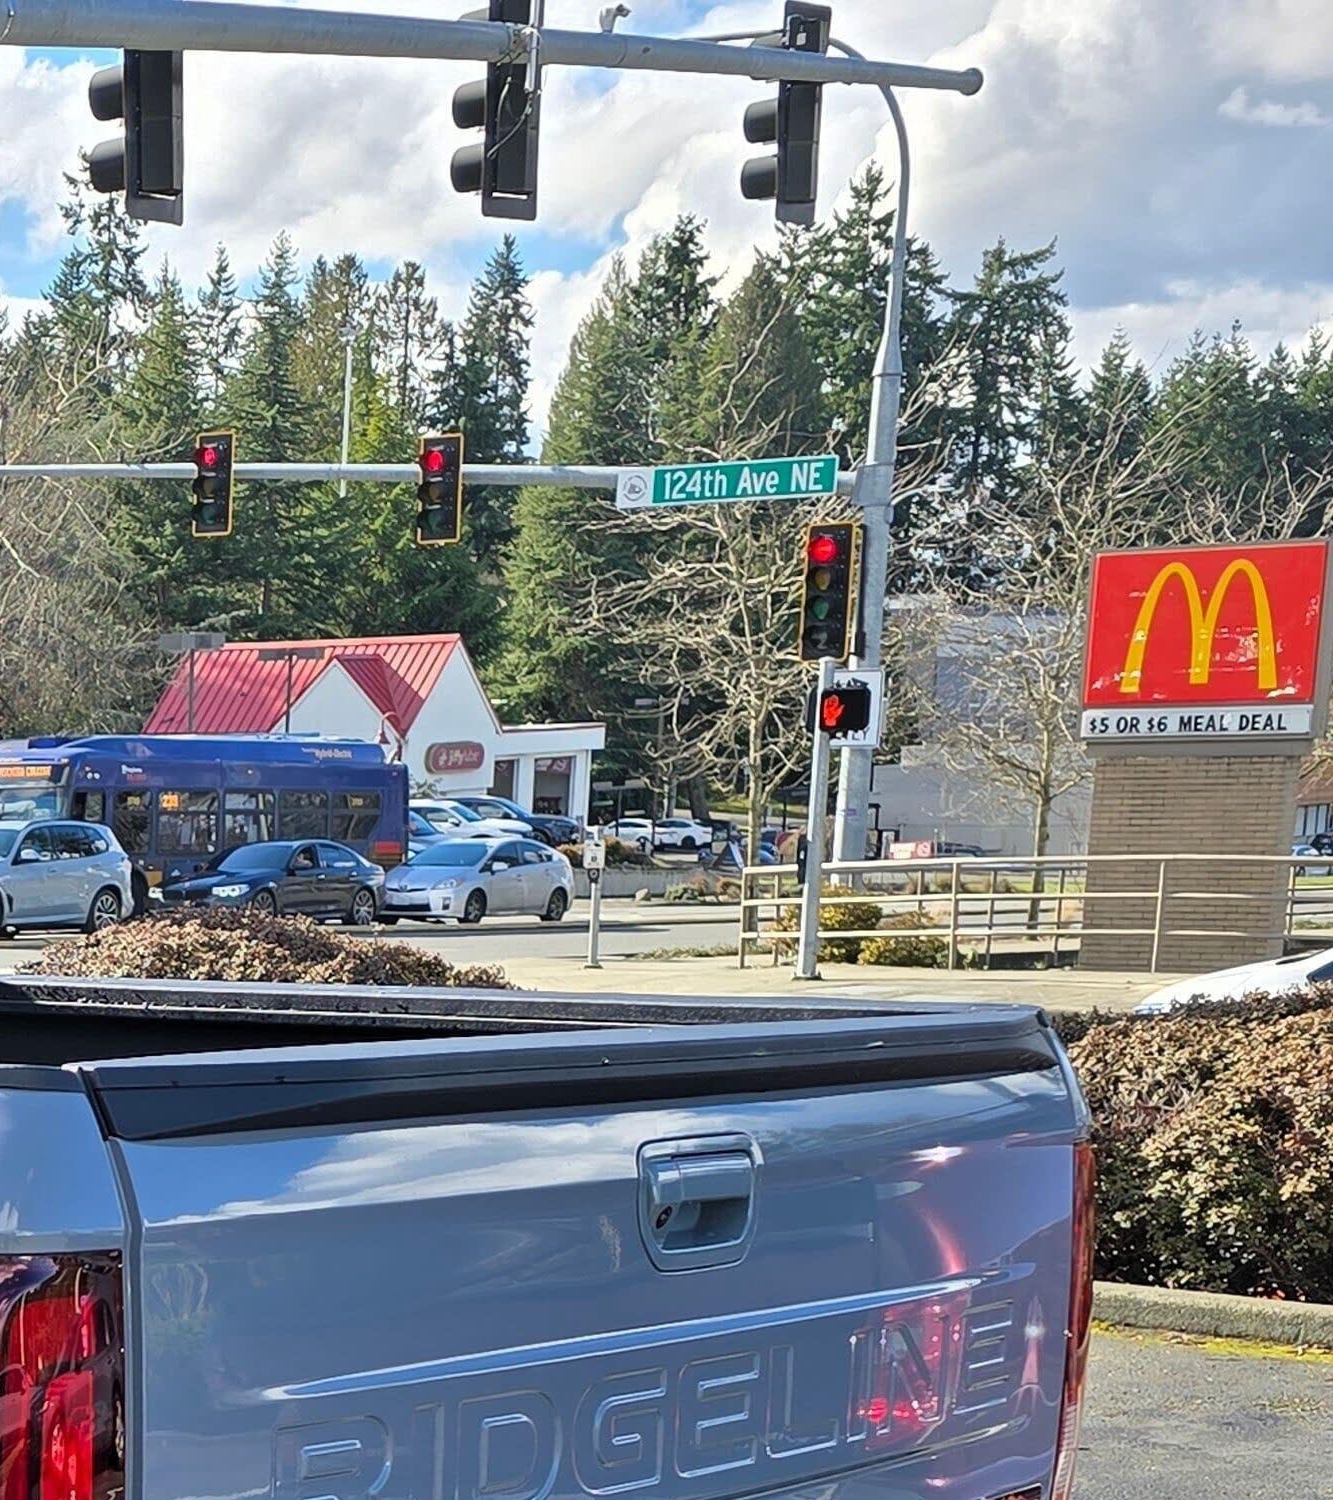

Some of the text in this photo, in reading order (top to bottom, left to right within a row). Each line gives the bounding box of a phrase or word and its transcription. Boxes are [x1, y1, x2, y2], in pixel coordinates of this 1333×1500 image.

[664, 468, 727, 500] 124th
[736, 466, 780, 496] Ave
[790, 461, 825, 492] NE
[1089, 713, 1287, 734] $5 OR $6 MEAL DEAL
